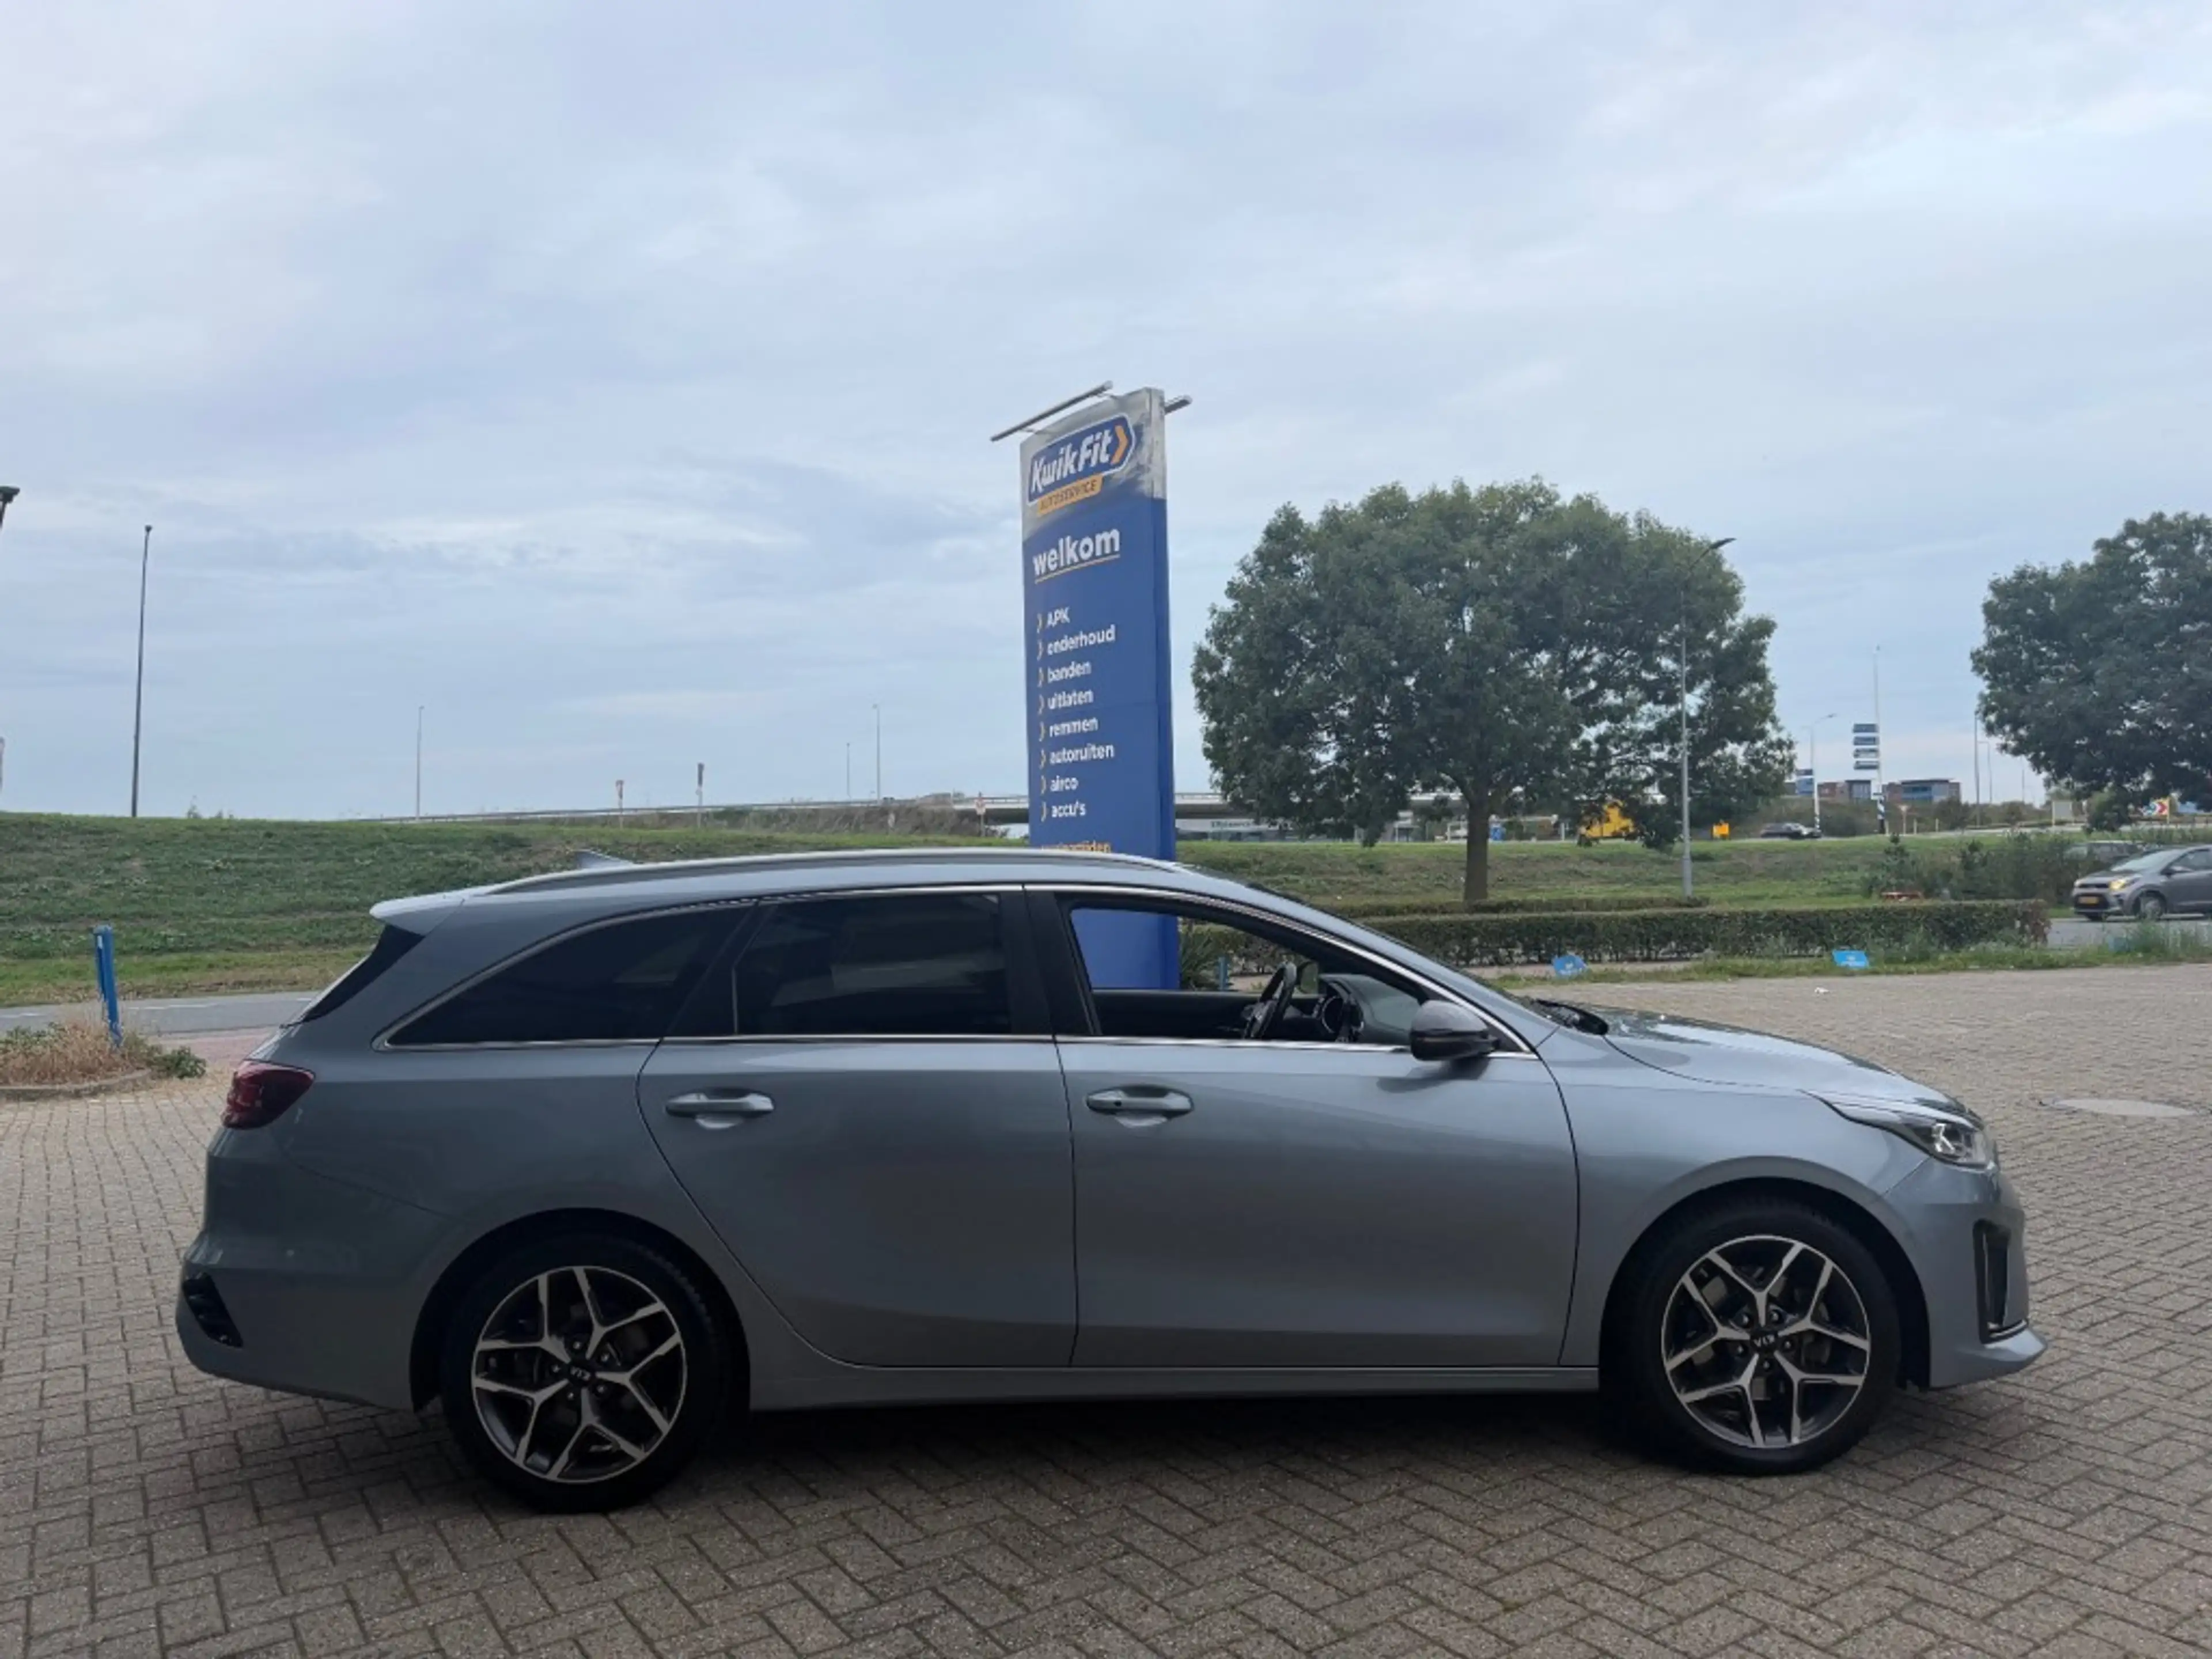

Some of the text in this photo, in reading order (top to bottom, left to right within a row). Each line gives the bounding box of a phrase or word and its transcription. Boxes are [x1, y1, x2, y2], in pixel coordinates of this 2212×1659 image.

[1033, 528, 1120, 577] welkom
[1046, 607, 1070, 628] APK
[1047, 624, 1116, 656] onderhoud
[1047, 662, 1092, 683] banden
[1047, 690, 1093, 710] uitlaten
[1049, 717, 1099, 738] remmen
[1050, 743, 1115, 766] autoruiten
[1050, 775, 1079, 792] airco
[1051, 800, 1086, 818] accu's
